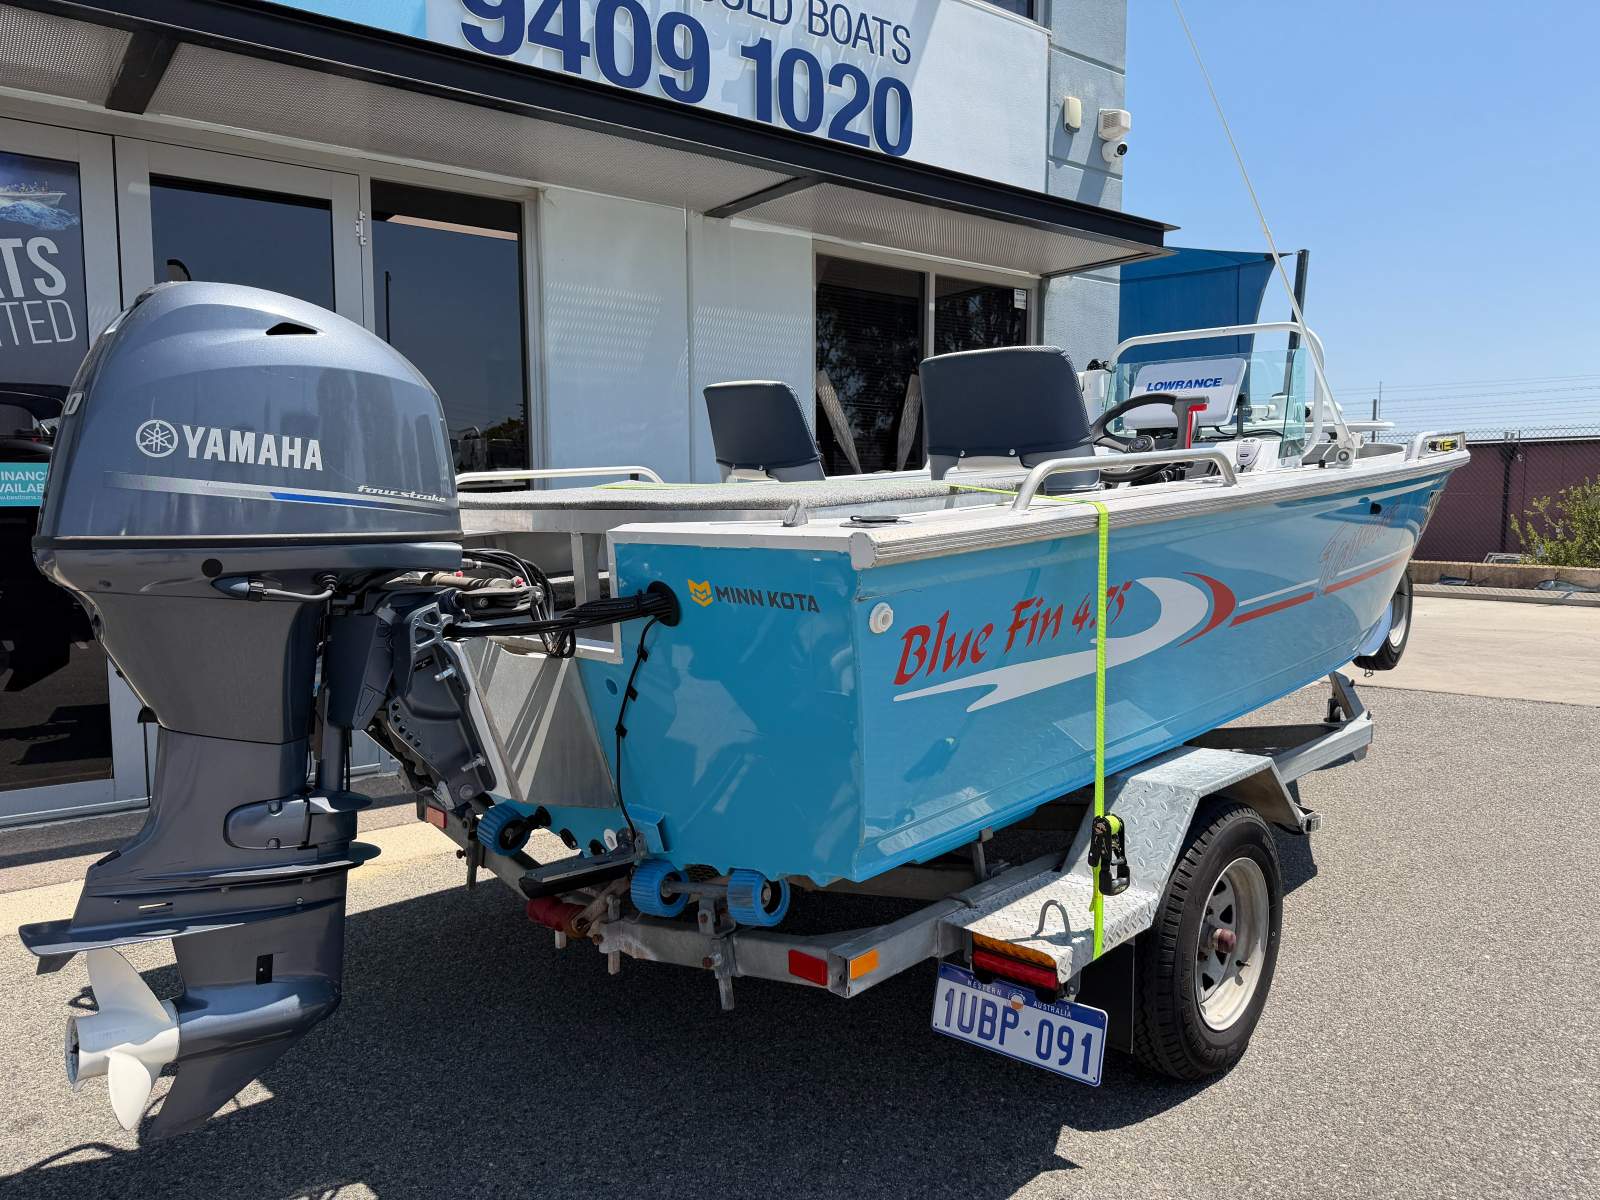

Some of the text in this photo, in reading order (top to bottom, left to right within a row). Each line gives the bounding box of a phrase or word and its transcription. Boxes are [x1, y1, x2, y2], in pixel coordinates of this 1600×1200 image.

[808, 0, 912, 64] BOATS
[461, 0, 913, 156] 9409 1020
[0, 237, 67, 297] TS
[1146, 377, 1223, 392] LOWRANCE
[182, 425, 323, 471] YAMAHA
[715, 585, 820, 613] MINN KOTA
[893, 609, 994, 685] Blue
[1003, 596, 1064, 655] Fin
[967, 980, 1072, 1018] WESTERN AUSTRALIA
